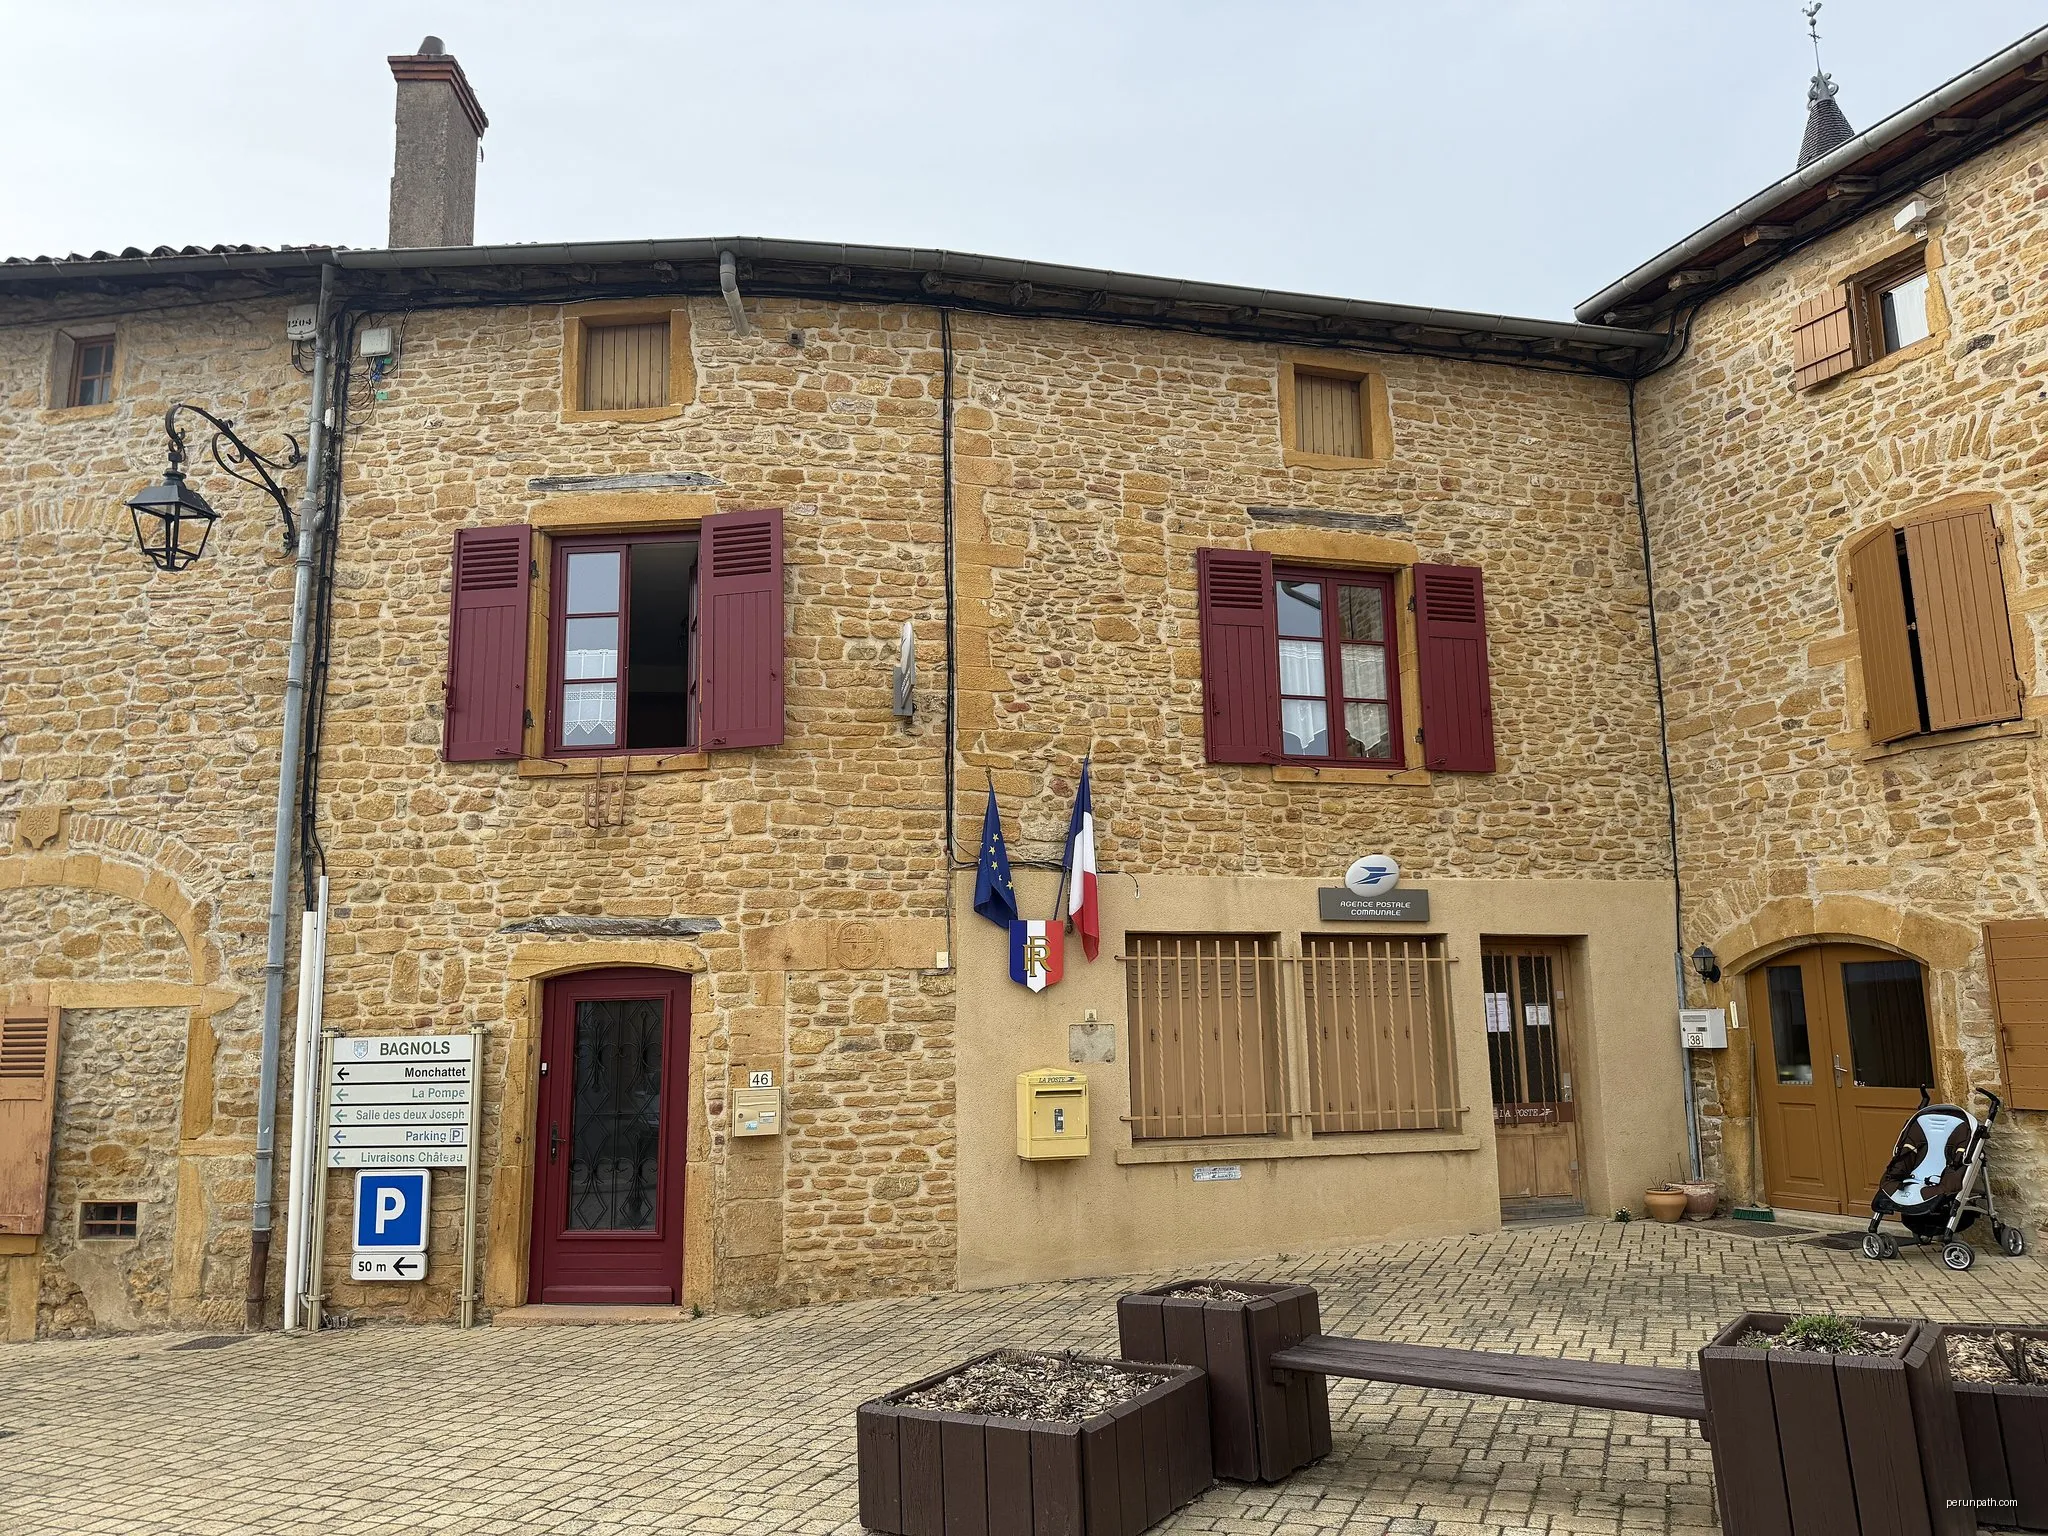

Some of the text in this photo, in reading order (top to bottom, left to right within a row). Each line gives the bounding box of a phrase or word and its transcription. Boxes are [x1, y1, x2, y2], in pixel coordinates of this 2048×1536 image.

[1690, 1035, 1701, 1045] 38
[380, 1041, 450, 1056] BAGNOLS
[404, 1067, 466, 1078] Monchattet
[752, 1073, 769, 1085] 46
[412, 1088, 465, 1100] La Pompe
[356, 1108, 465, 1121] Salle des deux Joseph
[405, 1131, 447, 1143] Parking
[361, 1151, 463, 1163] Livraisons Château
[375, 1187, 406, 1234] P
[358, 1261, 387, 1272] 50 m
